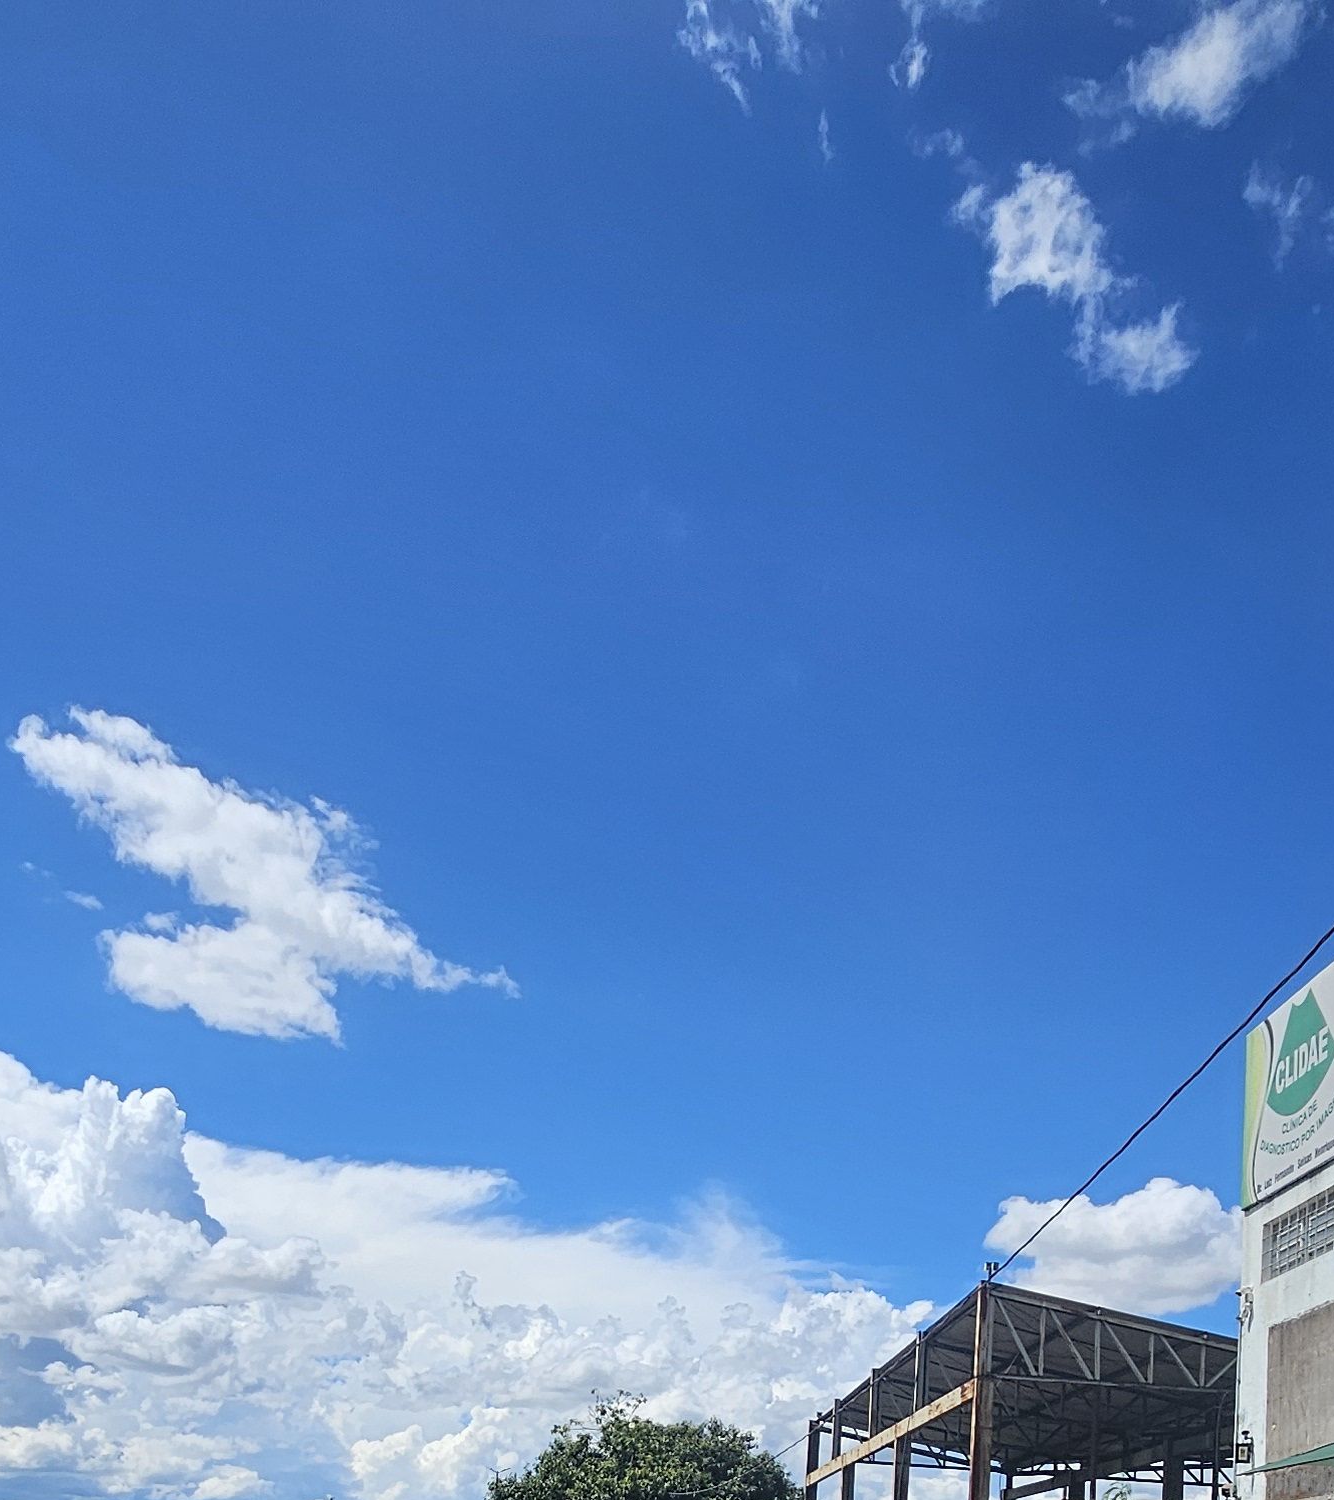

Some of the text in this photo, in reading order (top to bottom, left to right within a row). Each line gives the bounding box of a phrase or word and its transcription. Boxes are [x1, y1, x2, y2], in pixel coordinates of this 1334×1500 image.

[1275, 1024, 1329, 1094] CLIDAE
[1308, 1099, 1318, 1117] DE
[1301, 1124, 1315, 1145] POR
